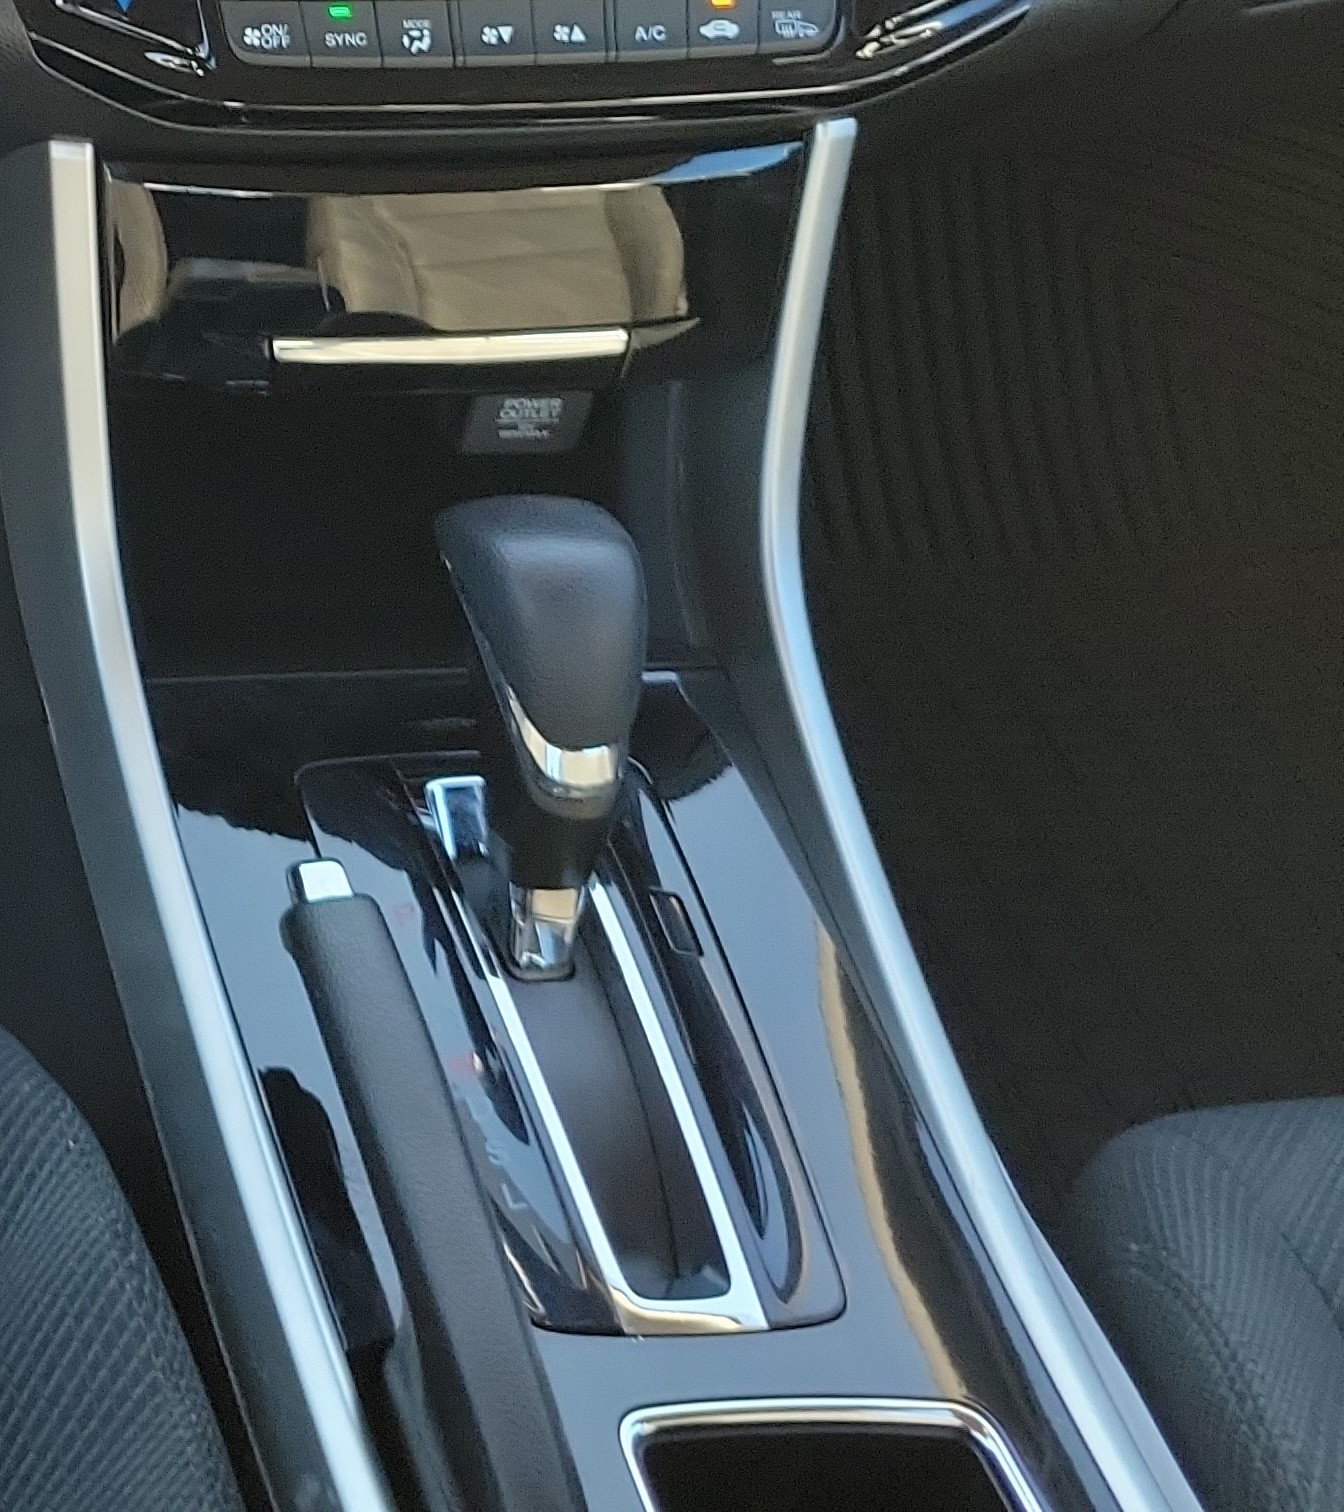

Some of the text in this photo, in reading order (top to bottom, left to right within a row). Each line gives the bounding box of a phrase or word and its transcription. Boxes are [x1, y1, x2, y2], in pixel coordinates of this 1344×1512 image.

[402, 19, 431, 30] MODE
[324, 31, 368, 48] SYNC
[634, 25, 667, 42] A/C
